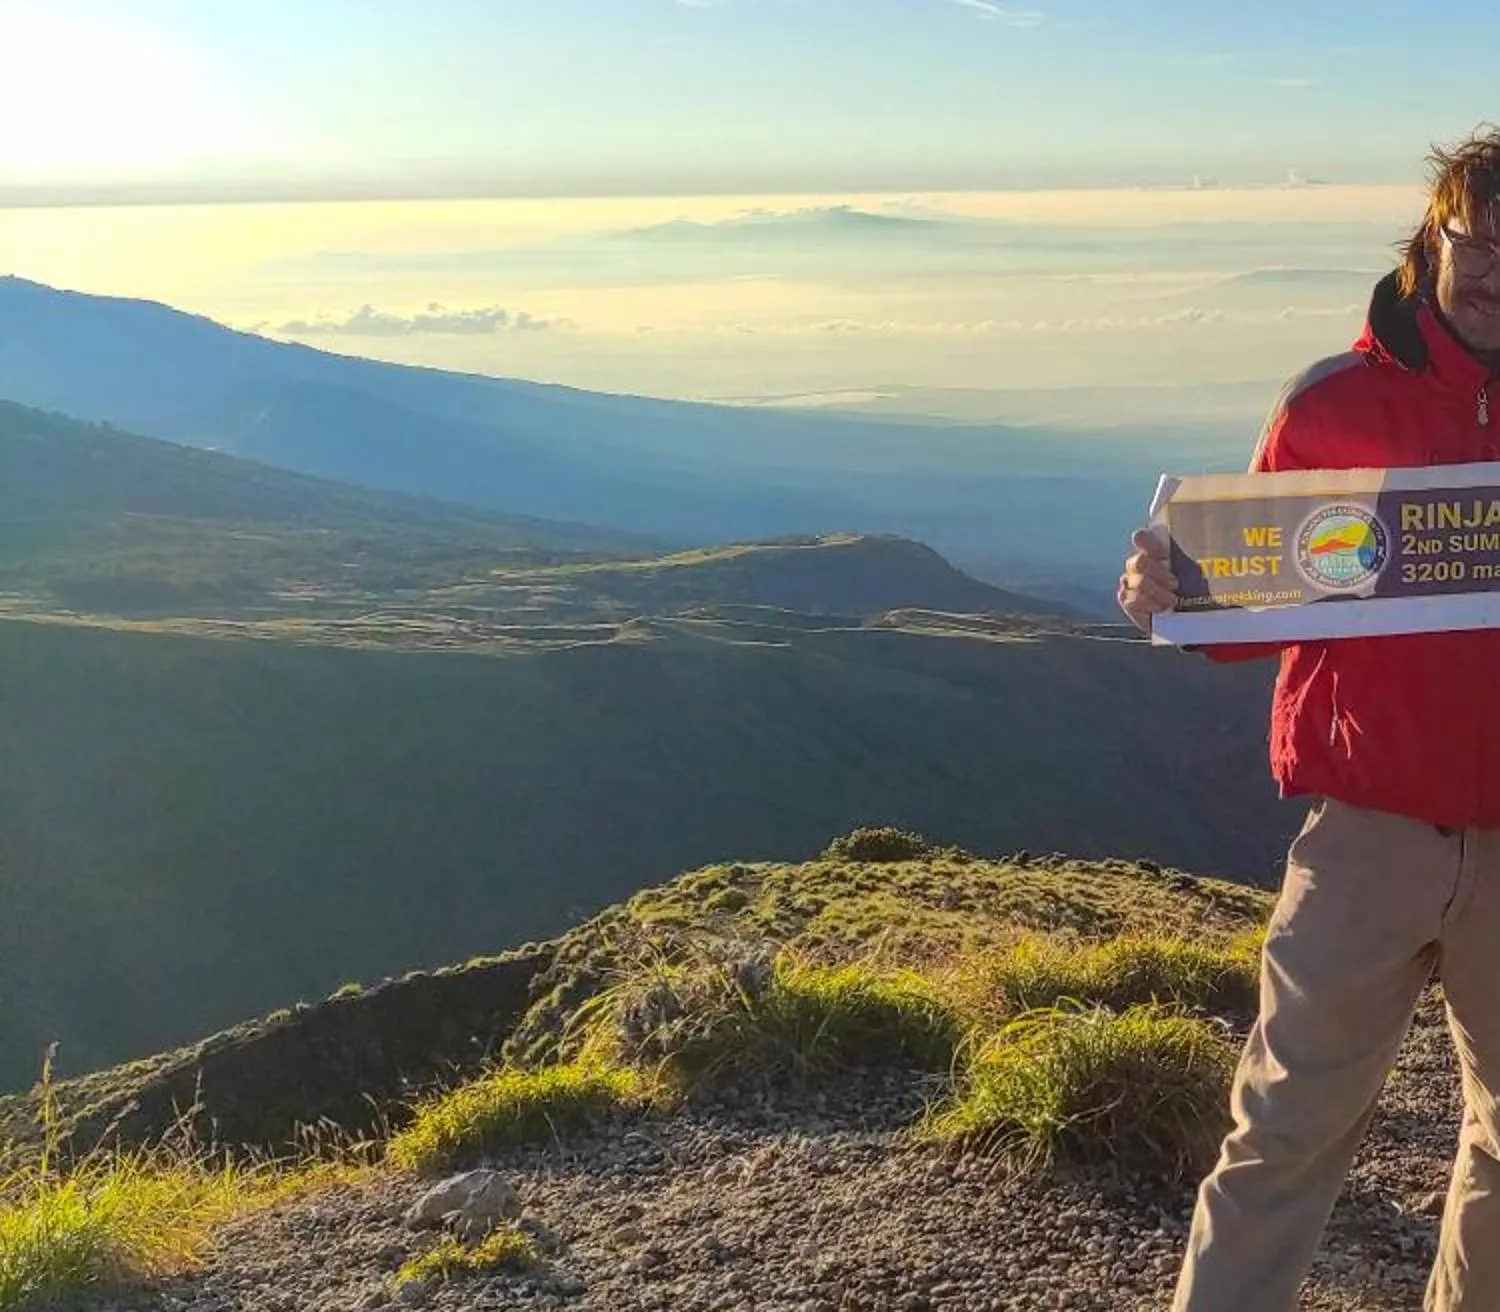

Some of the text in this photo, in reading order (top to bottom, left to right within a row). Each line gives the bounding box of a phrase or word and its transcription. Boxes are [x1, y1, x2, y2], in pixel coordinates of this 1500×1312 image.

[1243, 527, 1283, 547] WE
[1401, 534, 1443, 556] 2ND
[1196, 555, 1283, 577] TRUST
[1401, 561, 1465, 584] 3200
